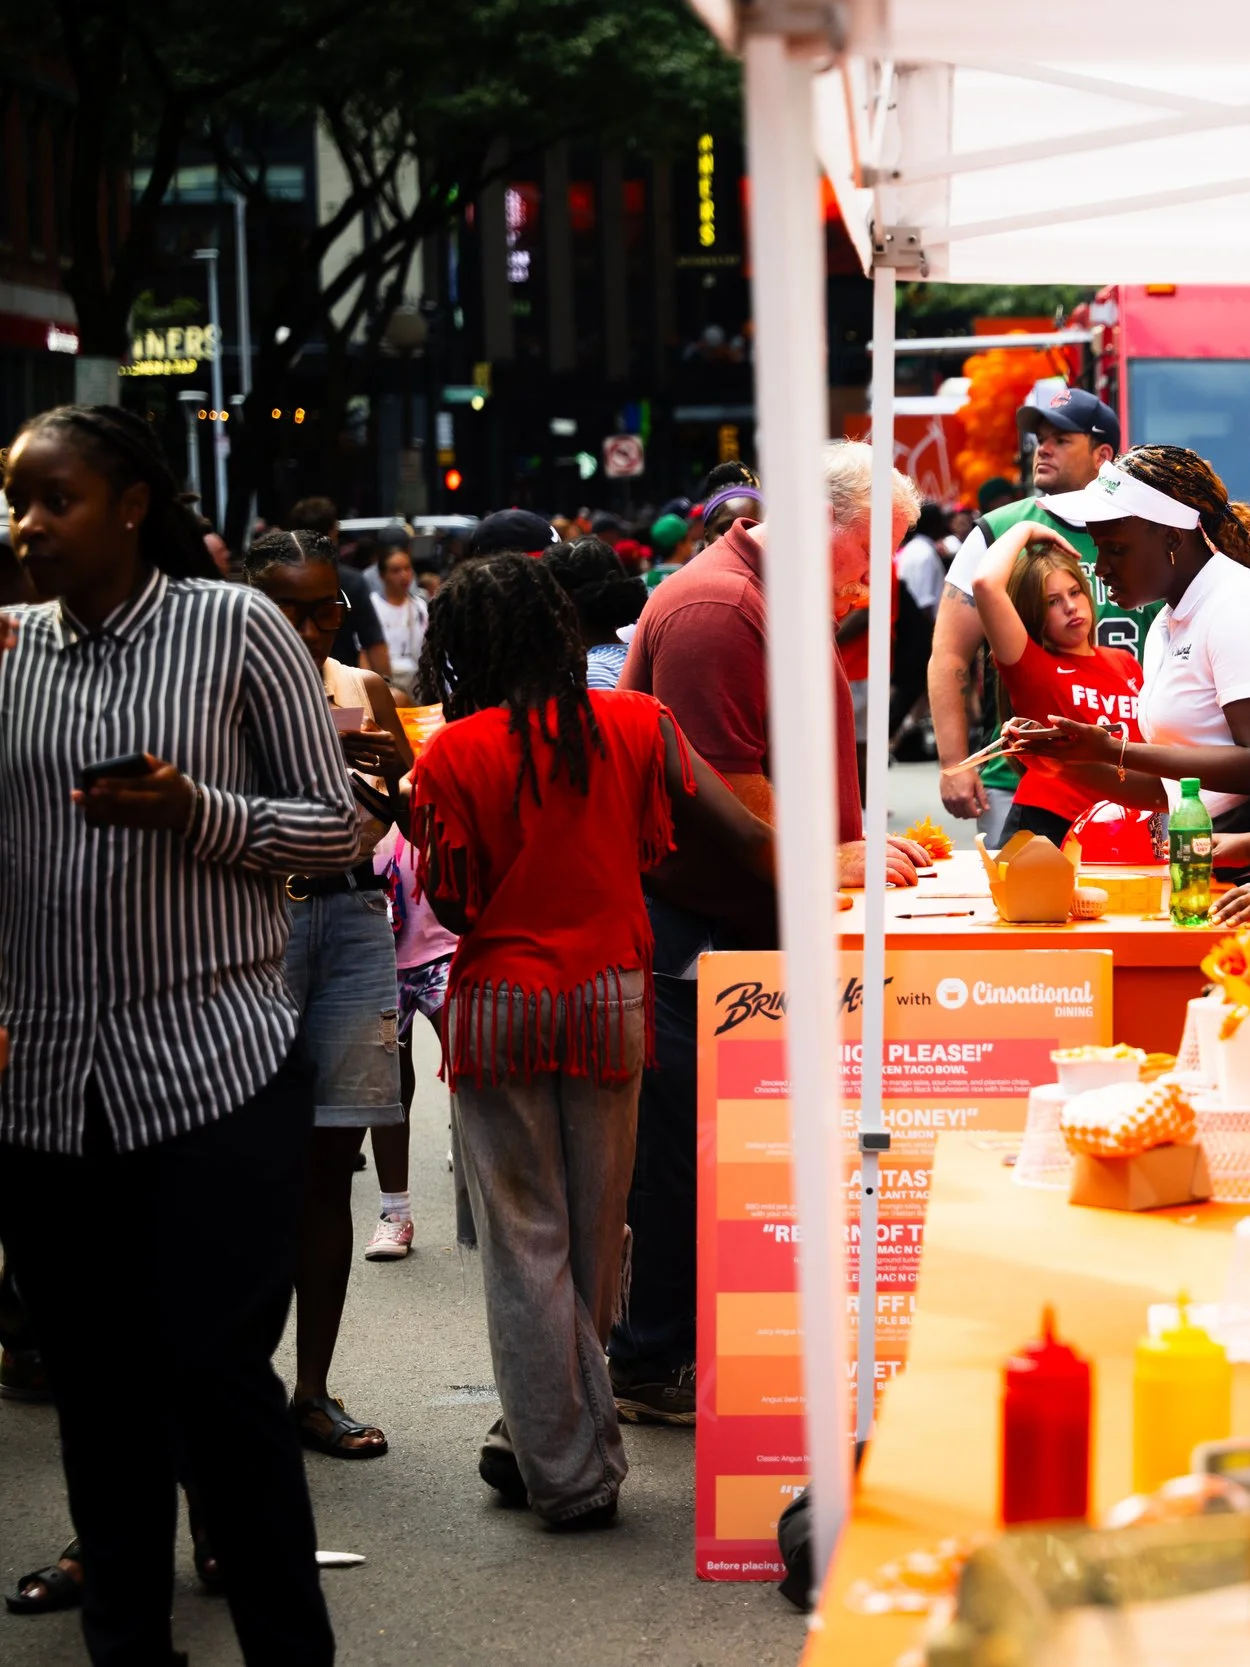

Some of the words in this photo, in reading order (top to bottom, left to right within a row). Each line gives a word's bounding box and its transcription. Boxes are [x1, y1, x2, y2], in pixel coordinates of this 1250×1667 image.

[972, 980, 1094, 1006] Cinsational
[897, 992, 931, 1006] with
[1054, 1006, 1094, 1018] DINING
[903, 1065, 934, 1074] TACO
[935, 1065, 968, 1074] BOWL
[876, 1225, 904, 1242] OF
[877, 1245, 902, 1255] MAC
[904, 1245, 913, 1255] N
[898, 1273, 906, 1282] N
[781, 1455, 803, 1463] Angus
[707, 1561, 740, 1570] Before
[742, 1561, 779, 1572] placing
